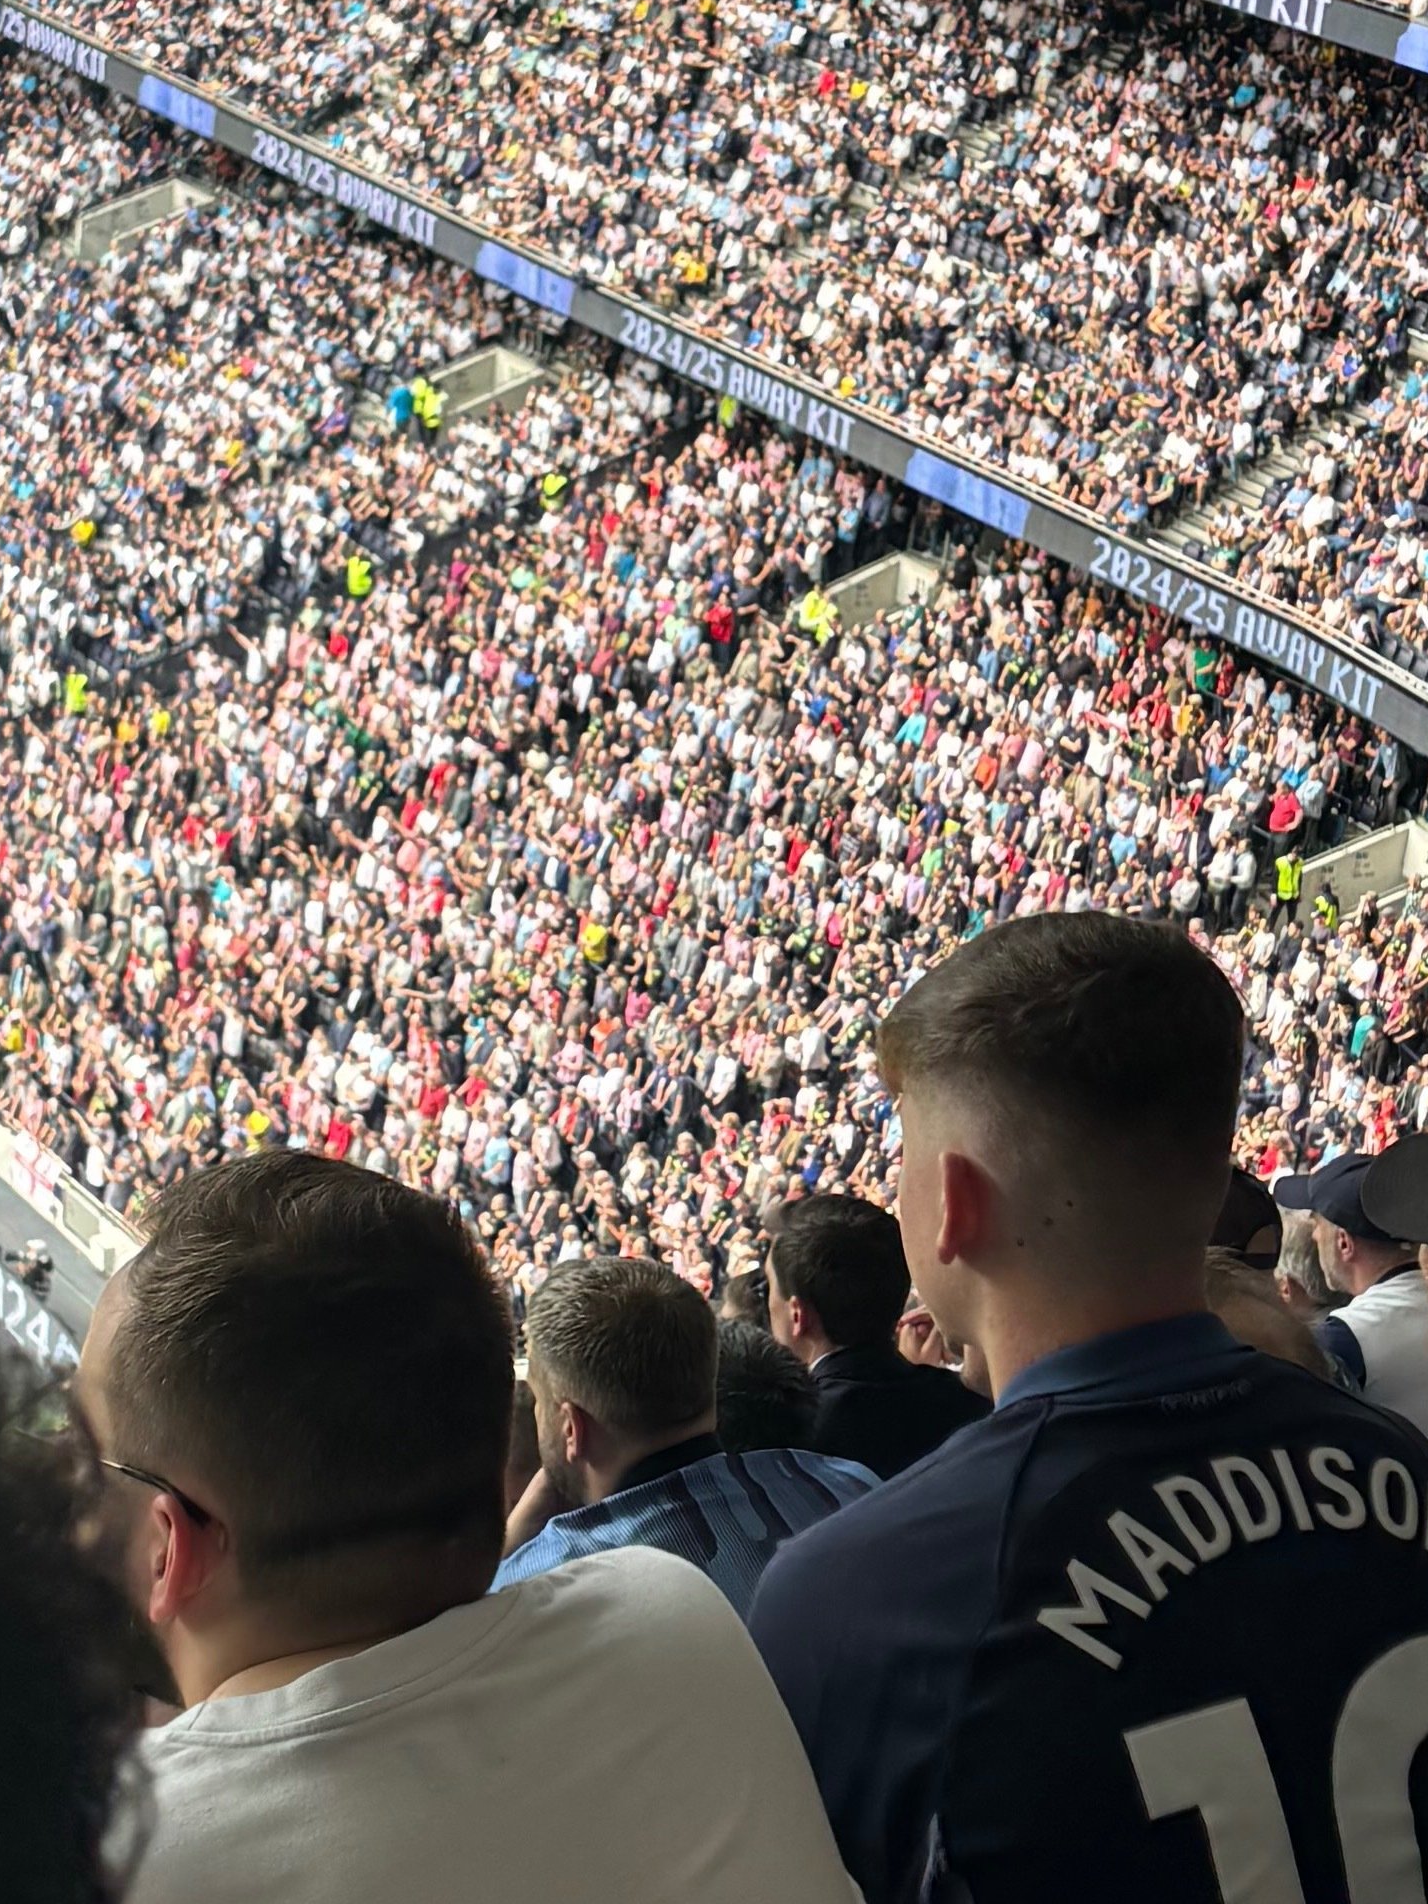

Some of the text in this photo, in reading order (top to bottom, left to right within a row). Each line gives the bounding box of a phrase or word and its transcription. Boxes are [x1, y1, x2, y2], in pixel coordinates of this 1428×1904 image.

[252, 129, 439, 246] 2024/25 AWAY KIT
[620, 309, 856, 452] 2024/25 AWAY KIT
[1090, 536, 1385, 721] 2024/25 AWAY KIT
